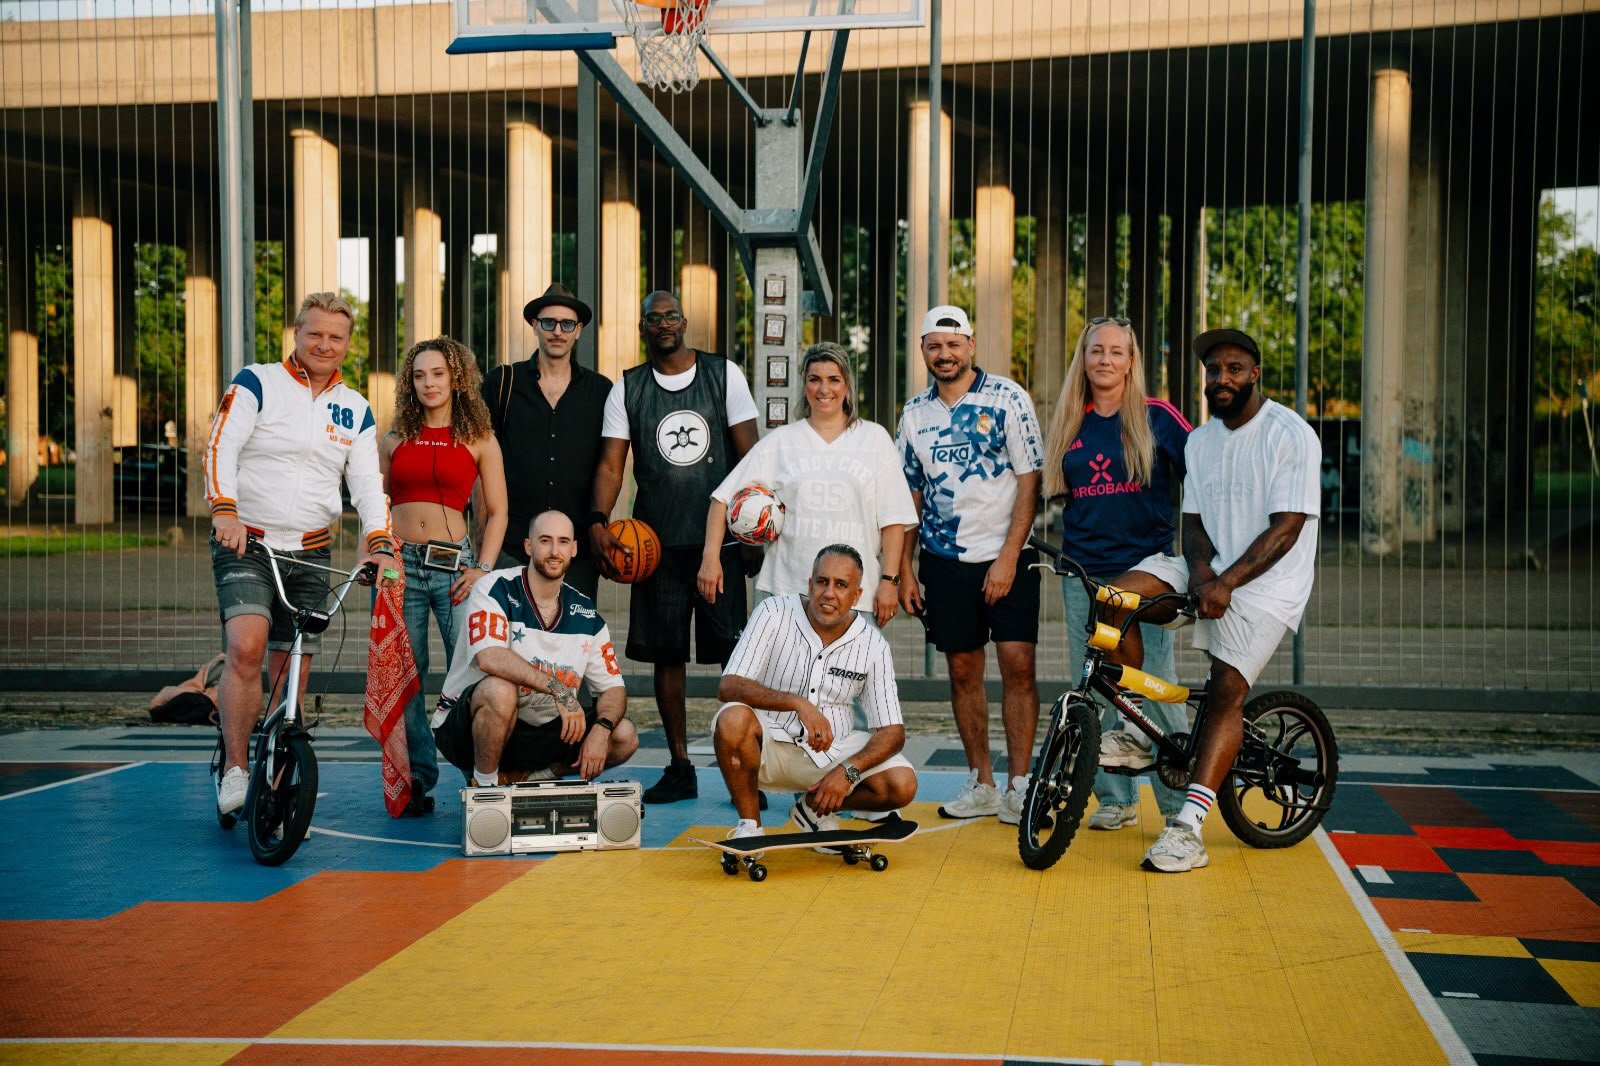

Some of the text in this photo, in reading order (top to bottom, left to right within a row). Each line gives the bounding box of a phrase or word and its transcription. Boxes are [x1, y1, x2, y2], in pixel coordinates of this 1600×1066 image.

[1072, 482, 1142, 498] ARGOBANK
[468, 609, 508, 646] 80
[1143, 677, 1167, 695] BMX
